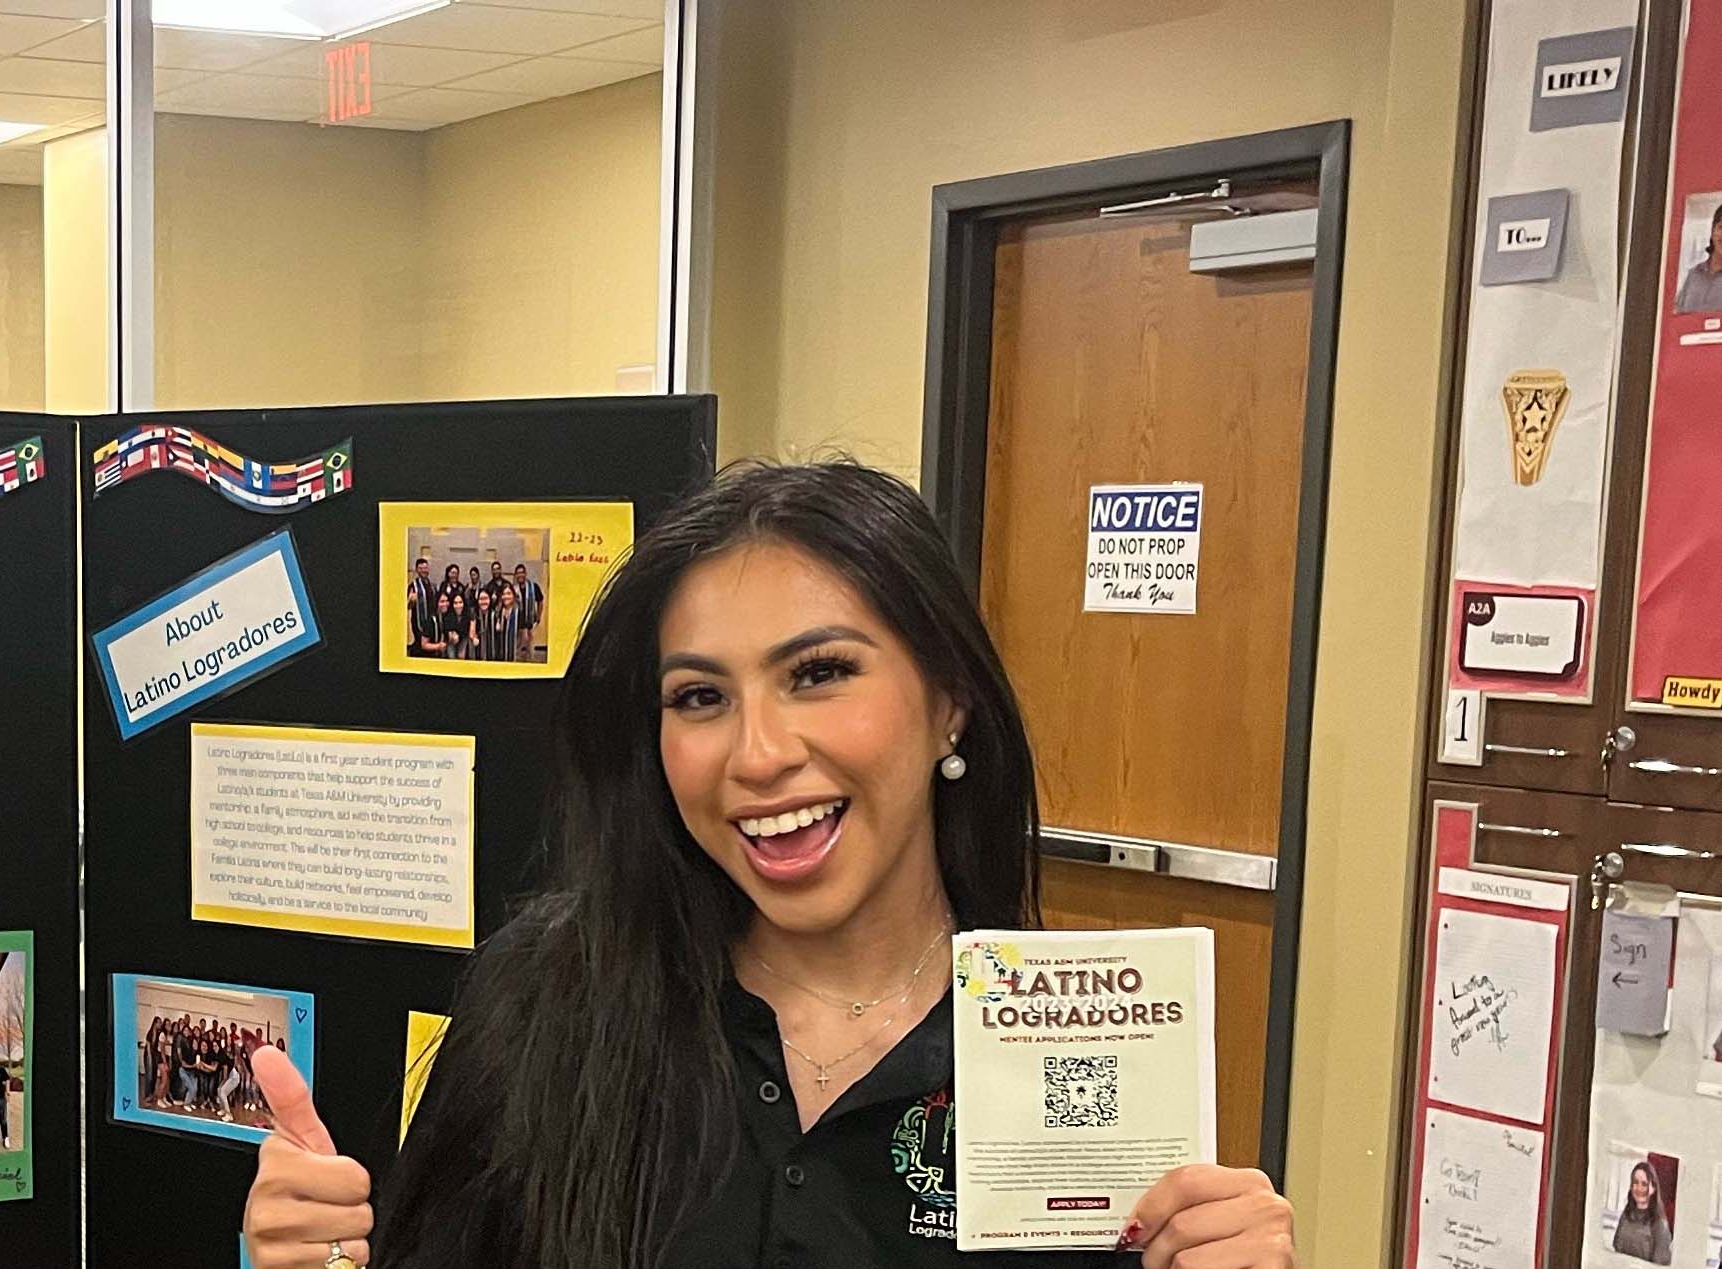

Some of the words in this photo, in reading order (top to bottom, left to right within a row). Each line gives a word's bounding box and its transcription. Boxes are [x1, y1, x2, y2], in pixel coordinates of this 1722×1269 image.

[1548, 68, 1614, 91] LIKELY
[1091, 495, 1198, 528] NOTICE
[1098, 538, 1116, 555] DO
[1119, 538, 1145, 555] NOT
[1148, 538, 1186, 555] PROP
[1088, 562, 1120, 579] OPEN
[1123, 562, 1152, 580] THIS
[1155, 563, 1196, 581] DOOR
[1103, 582, 1143, 601] Thank
[1148, 583, 1175, 606] You
[1468, 602, 1491, 615] A2A
[164, 599, 224, 647] About
[1516, 633, 1524, 645] to
[124, 671, 182, 714] Latino
[181, 610, 298, 683] Logradores
[1668, 681, 1721, 705] Howdy
[1453, 696, 1468, 743] 1
[1469, 880, 1533, 902] SIGNATURES
[1610, 932, 1647, 965] Sign
[1024, 957, 1052, 967] TEXAS
[1074, 956, 1128, 966] UNIVERSITY
[1010, 967, 1144, 997] LATINO
[982, 1001, 1184, 1030] LOGRADORES
[1034, 1034, 1102, 1044] APPLICATIONS
[1103, 1034, 1126, 1043] NOW
[909, 1203, 956, 1228] Lati
[908, 1222, 958, 1240] Lograd
[979, 1231, 1022, 1239] PROGRAM
[1030, 1230, 1061, 1238] EVENTS
[1069, 1229, 1120, 1238] RESOURCES
